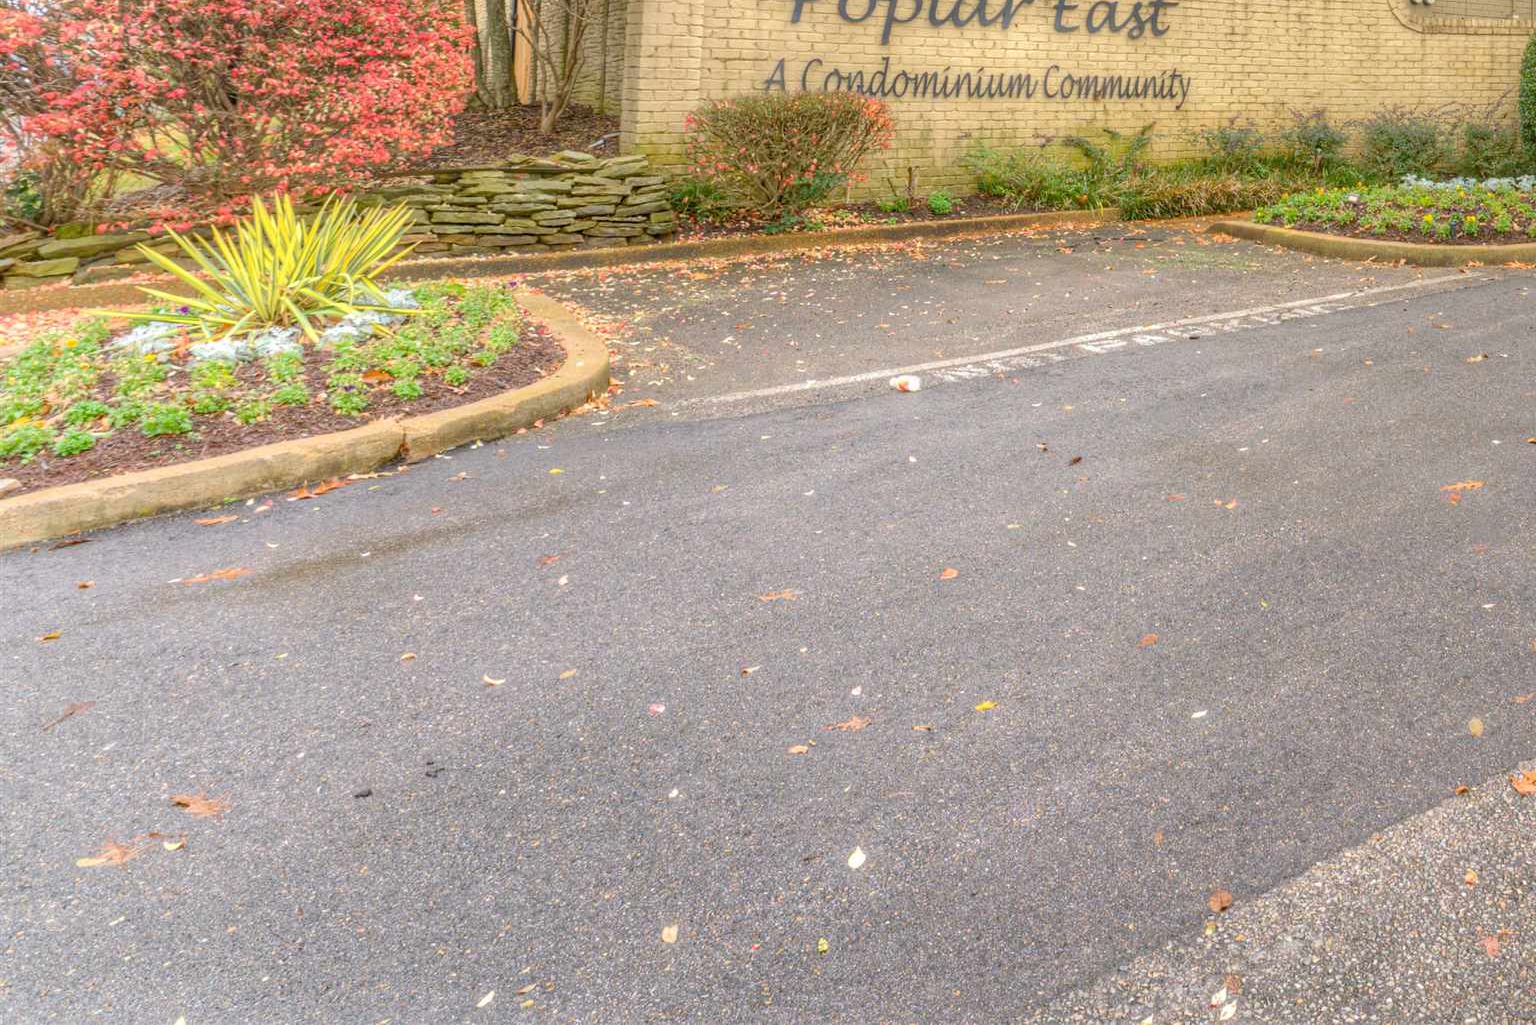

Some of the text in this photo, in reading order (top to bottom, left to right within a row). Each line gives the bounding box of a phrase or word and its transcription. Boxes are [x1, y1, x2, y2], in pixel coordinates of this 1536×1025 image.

[763, 56, 1191, 110] A Condominium Community
